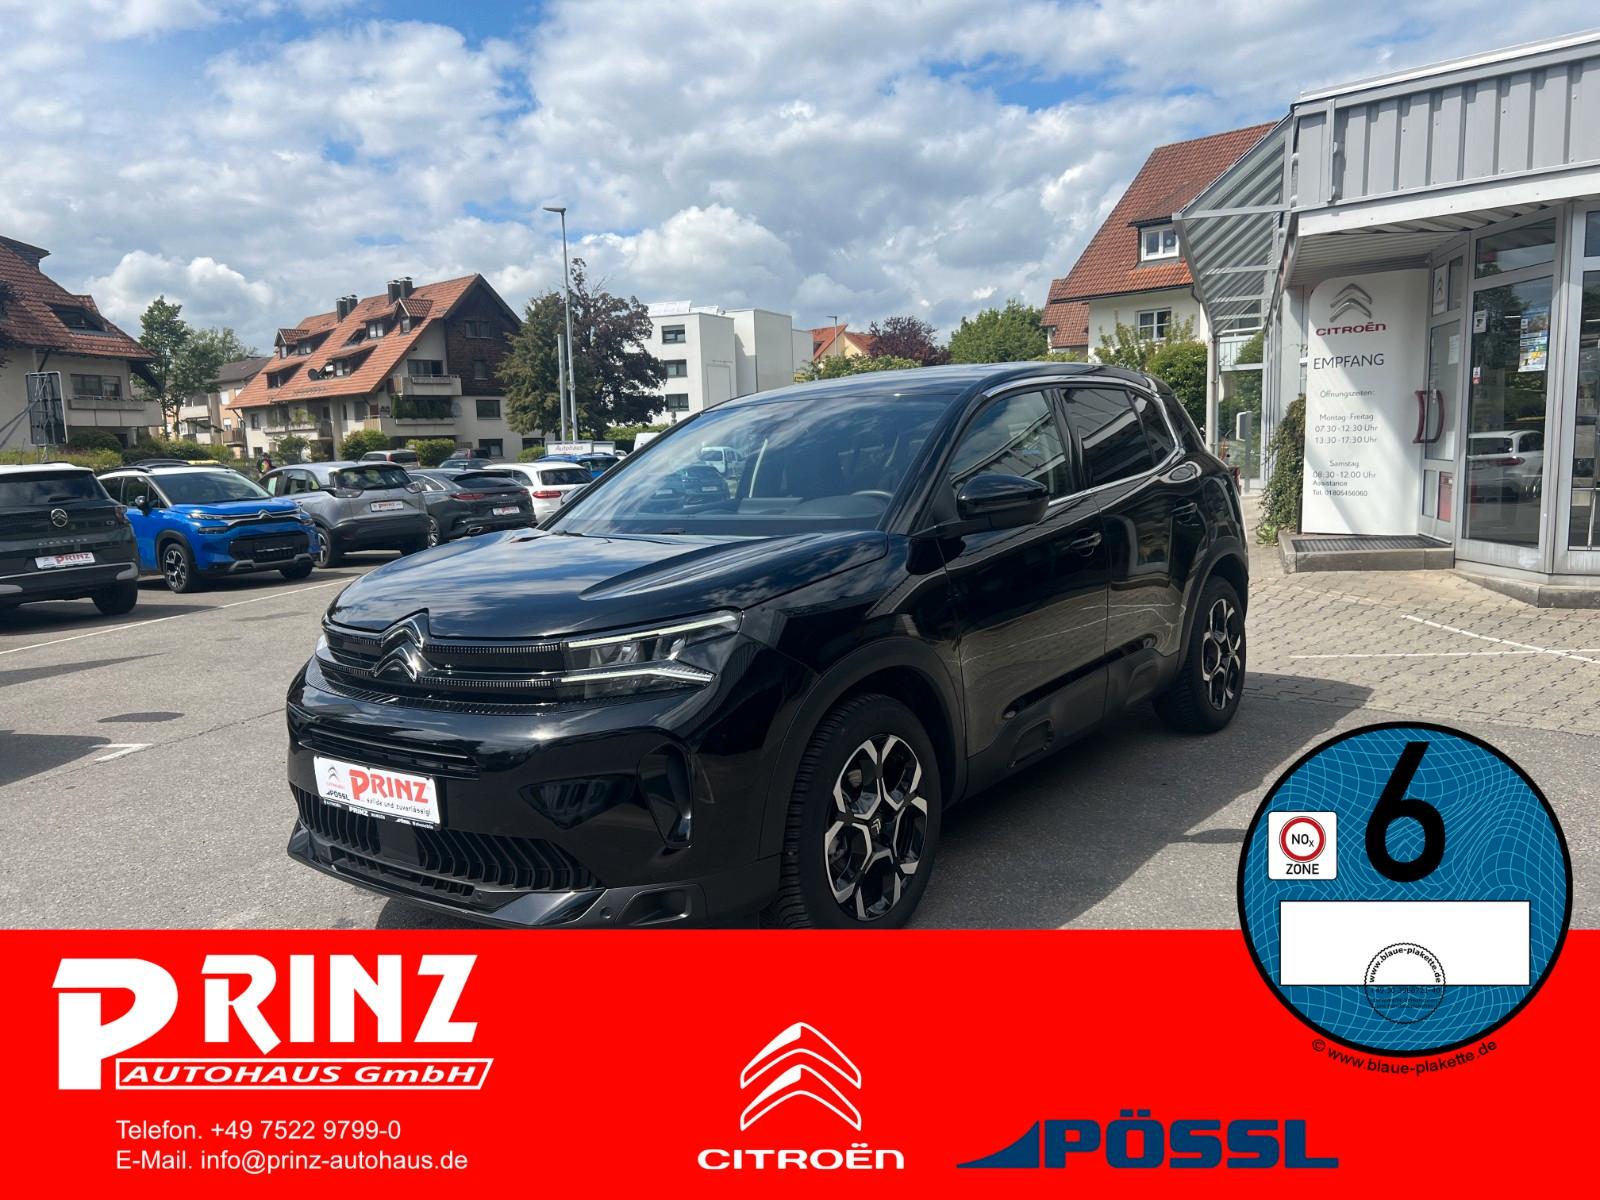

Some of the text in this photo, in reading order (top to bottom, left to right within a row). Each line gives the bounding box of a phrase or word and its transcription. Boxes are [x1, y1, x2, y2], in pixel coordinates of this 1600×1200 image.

[1316, 322, 1386, 336] CITROËN
[1313, 353, 1385, 370] EMPFANG
[1320, 413, 1346, 422] Montag
[1350, 412, 1374, 421] Freitag
[1364, 424, 1377, 432] Uhr
[1364, 435, 1377, 443] Uhr
[54, 553, 91, 565] PRINZ
[348, 769, 429, 804] PRINZ
